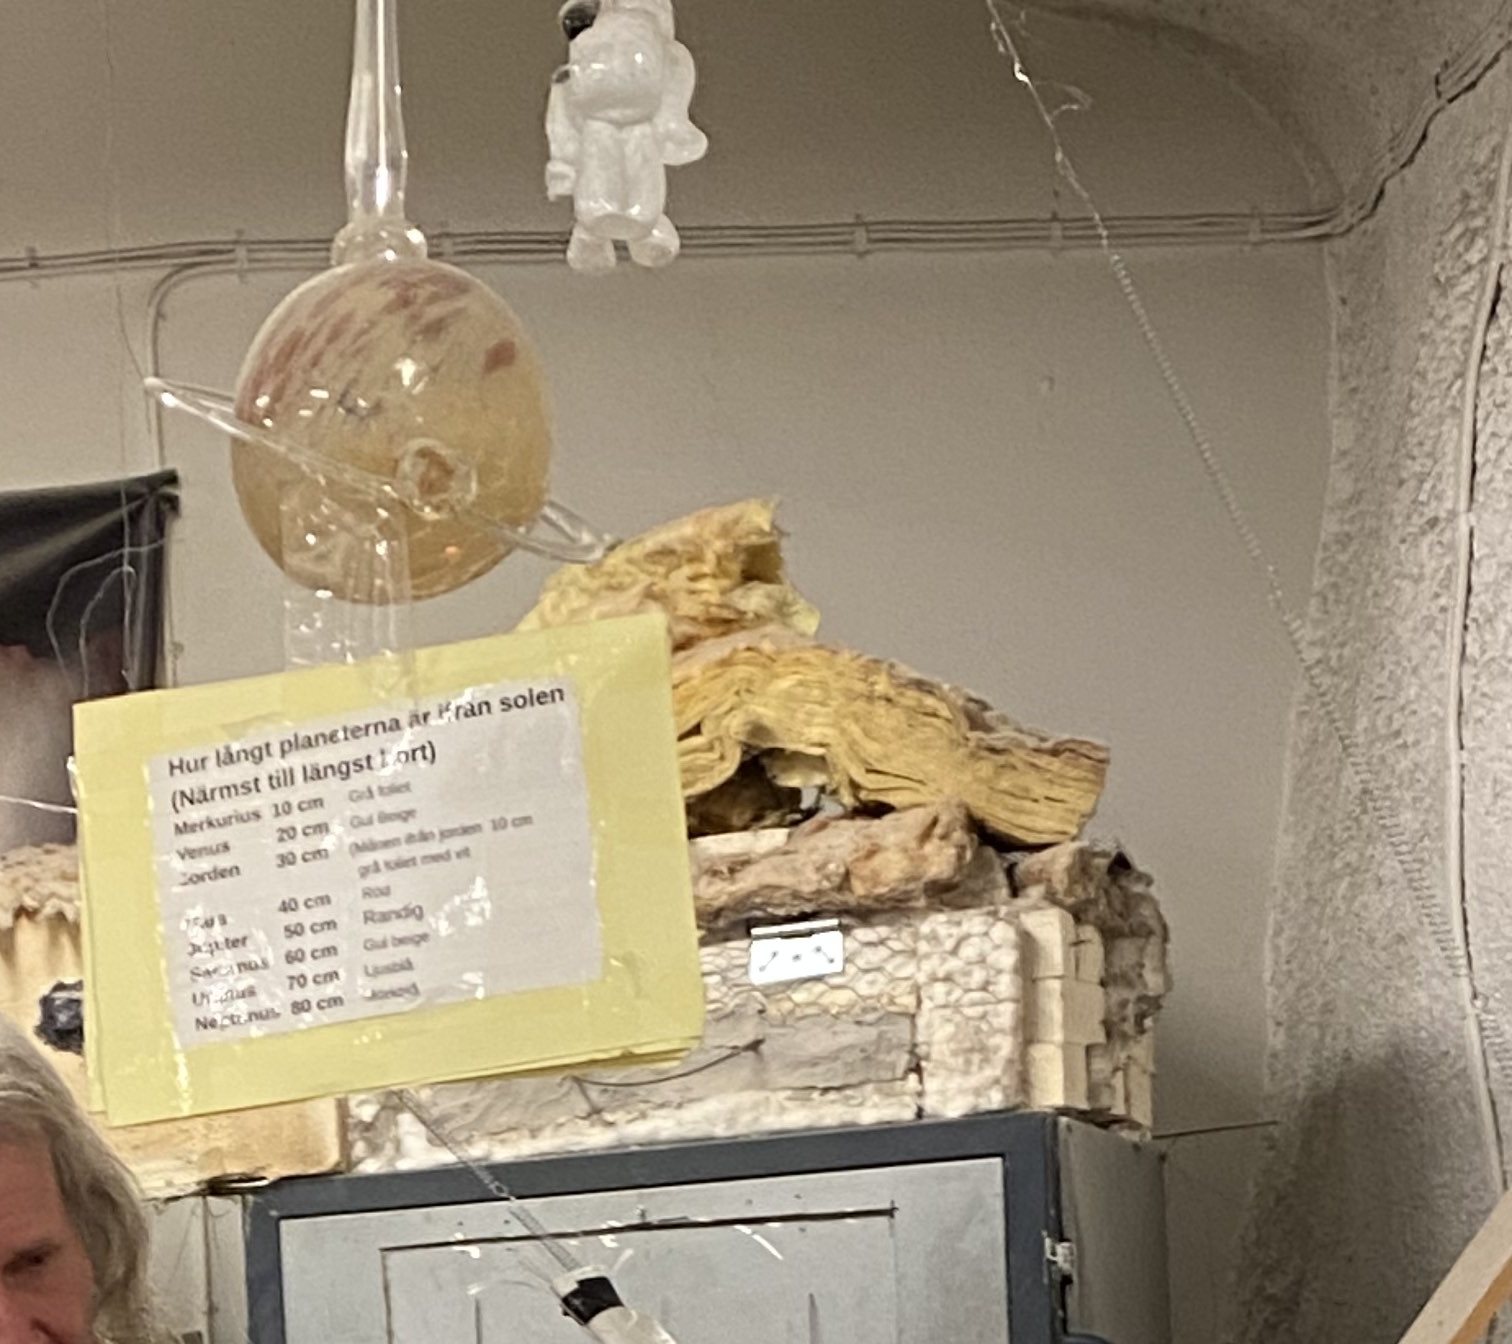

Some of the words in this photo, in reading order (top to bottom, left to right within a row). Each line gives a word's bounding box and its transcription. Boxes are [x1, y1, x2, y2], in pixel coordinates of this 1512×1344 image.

[168, 755, 208, 777] Hur
[215, 741, 273, 769] långt
[279, 717, 401, 759] planeterna
[407, 706, 432, 729] är
[499, 687, 565, 714] solen
[170, 776, 261, 814] (Närmst
[268, 766, 295, 791] till
[302, 753, 373, 782] längst
[173, 808, 262, 837] Merkurius
[272, 799, 292, 818] 10
[297, 796, 325, 813] cm
[175, 841, 231, 861] Venus
[276, 825, 297, 843] 20
[302, 821, 330, 838] cm
[178, 864, 241, 887] orden
[276, 852, 296, 869] 30
[301, 848, 329, 864] cm
[277, 897, 299, 914] 40
[303, 893, 332, 910] cm
[309, 917, 338, 935] cm
[362, 903, 424, 925] Randig
[284, 947, 306, 965] 60
[310, 944, 338, 961] cm
[191, 984, 258, 1008] Urnus
[287, 974, 308, 990] 70
[312, 969, 341, 985] cm
[194, 1007, 282, 1032] Netnus
[290, 999, 312, 1015] 80
[316, 994, 345, 1010] cm
